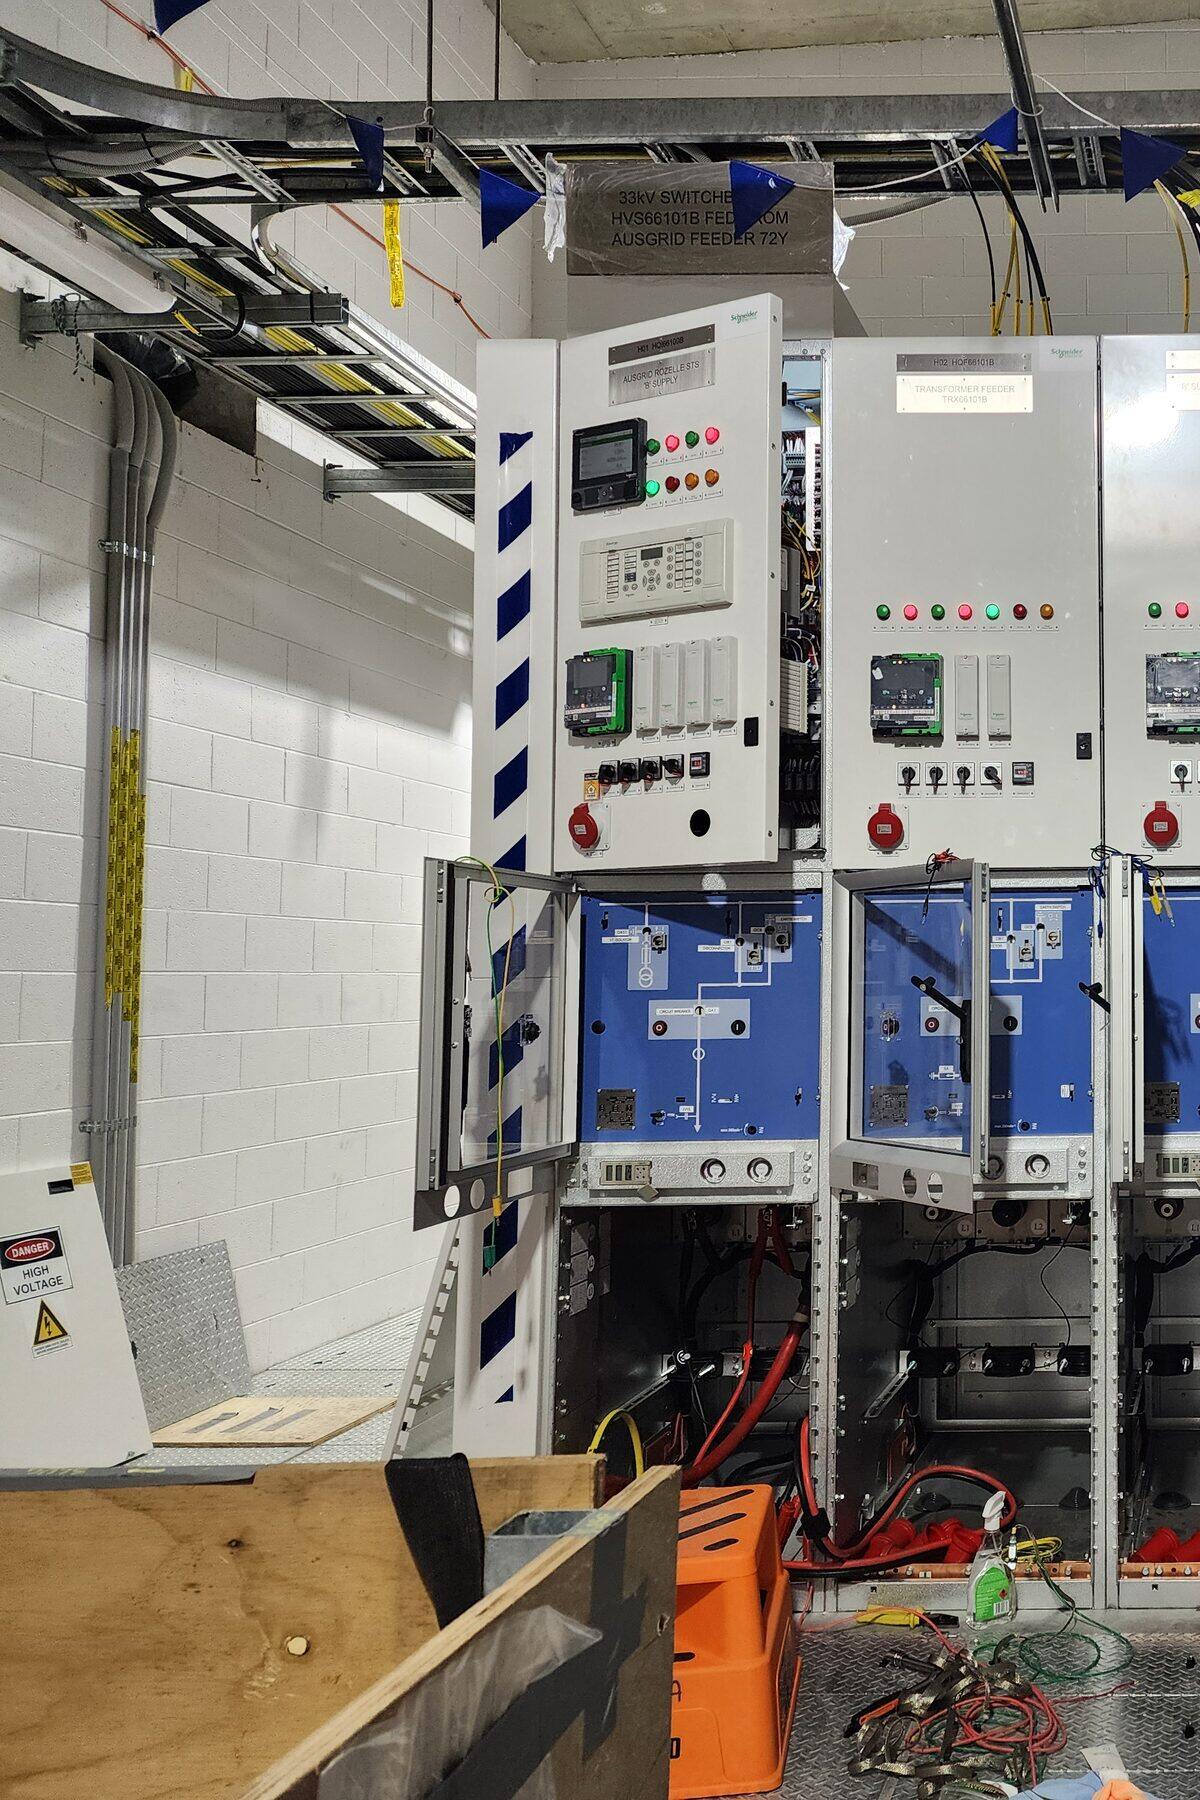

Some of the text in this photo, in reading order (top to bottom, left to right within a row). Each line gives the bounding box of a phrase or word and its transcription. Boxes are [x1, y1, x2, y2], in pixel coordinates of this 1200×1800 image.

[619, 190, 655, 205] 33kV
[611, 211, 700, 225] HVS66101B
[705, 211, 735, 225] FED
[611, 231, 789, 246] AUSGRID FEEDER 72Y
[933, 358, 948, 367] H02
[622, 360, 700, 384] AUSGRID ROZELLE STS
[652, 375, 678, 389] SUPPLY
[915, 385, 1015, 393] TRANSFORMER FEEDER
[11, 1242, 50, 1258] DANGER
[22, 1265, 49, 1279] HIGH
[13, 1275, 64, 1295] VOLTAGE
